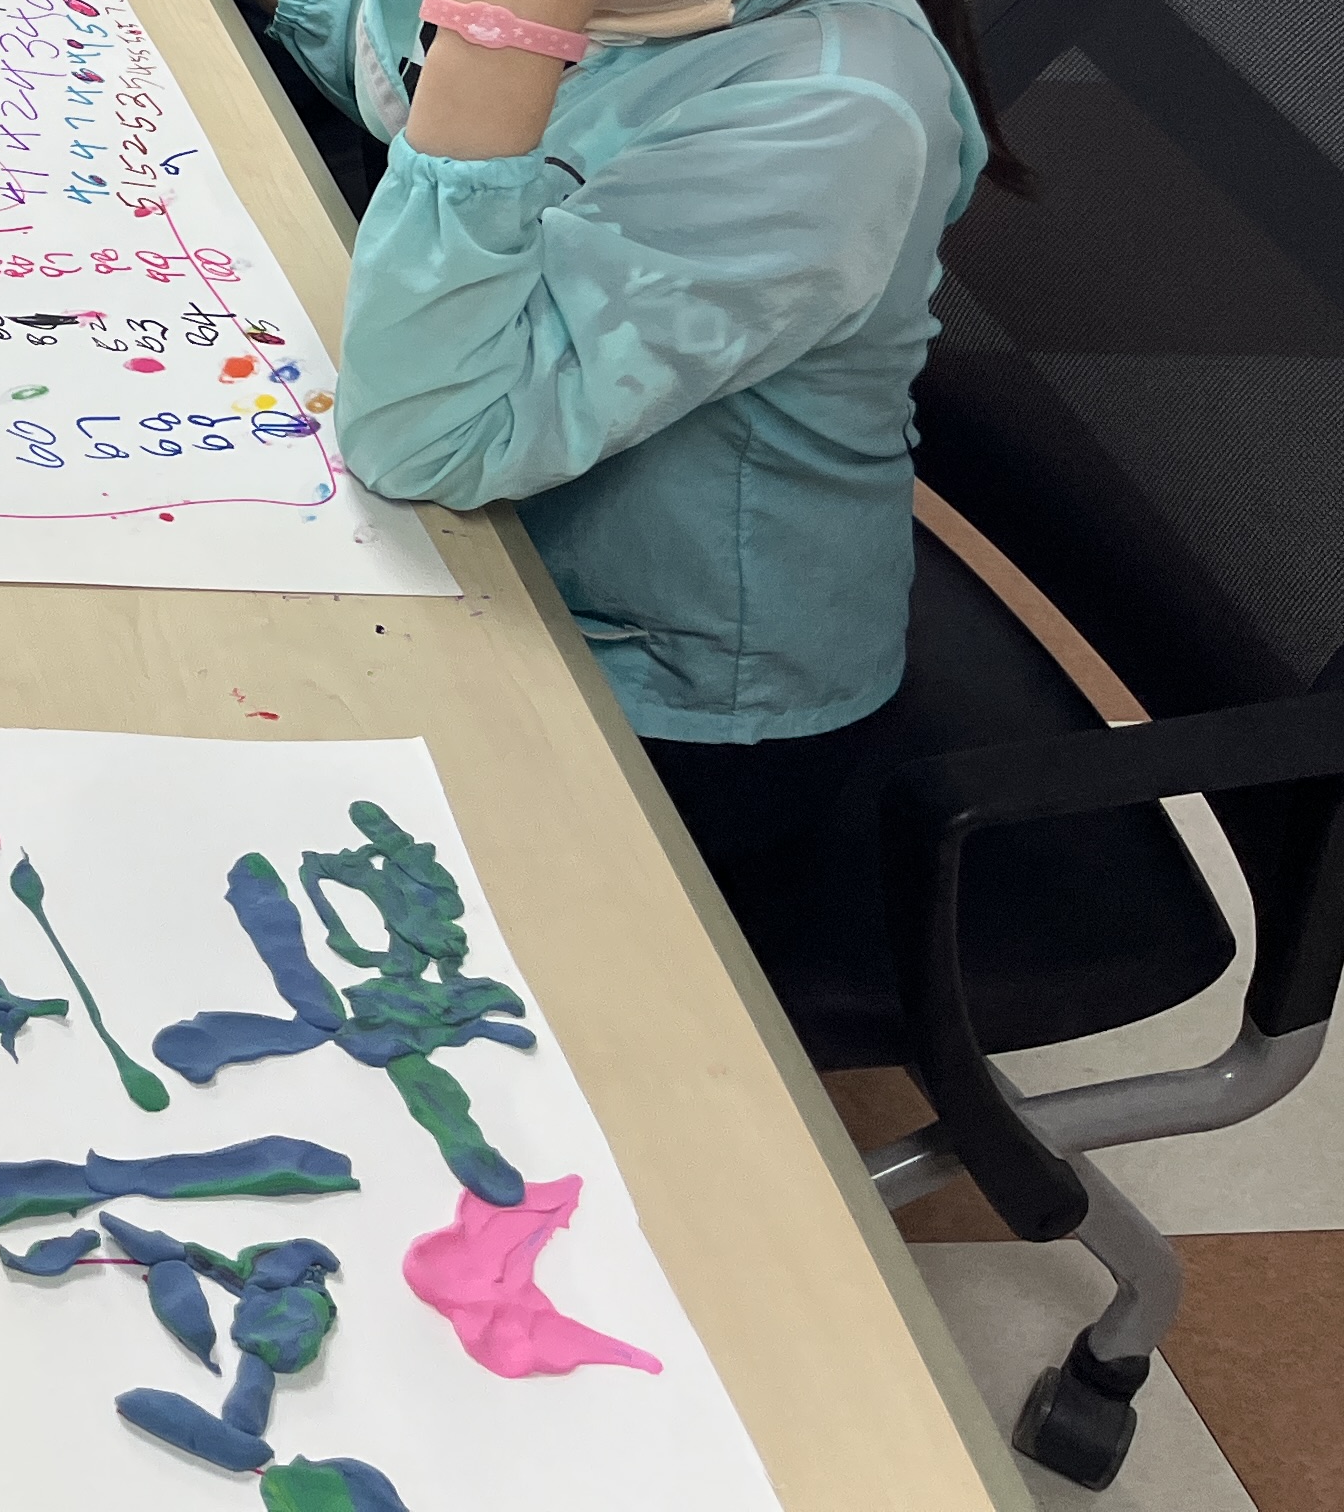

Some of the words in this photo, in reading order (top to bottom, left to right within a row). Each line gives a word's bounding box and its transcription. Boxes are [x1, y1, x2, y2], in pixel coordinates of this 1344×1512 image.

[64, 116, 108, 160] 47
[62, 170, 110, 204] 46
[39, 252, 82, 279] 97
[138, 412, 184, 457] 68
[186, 413, 242, 452] 69
